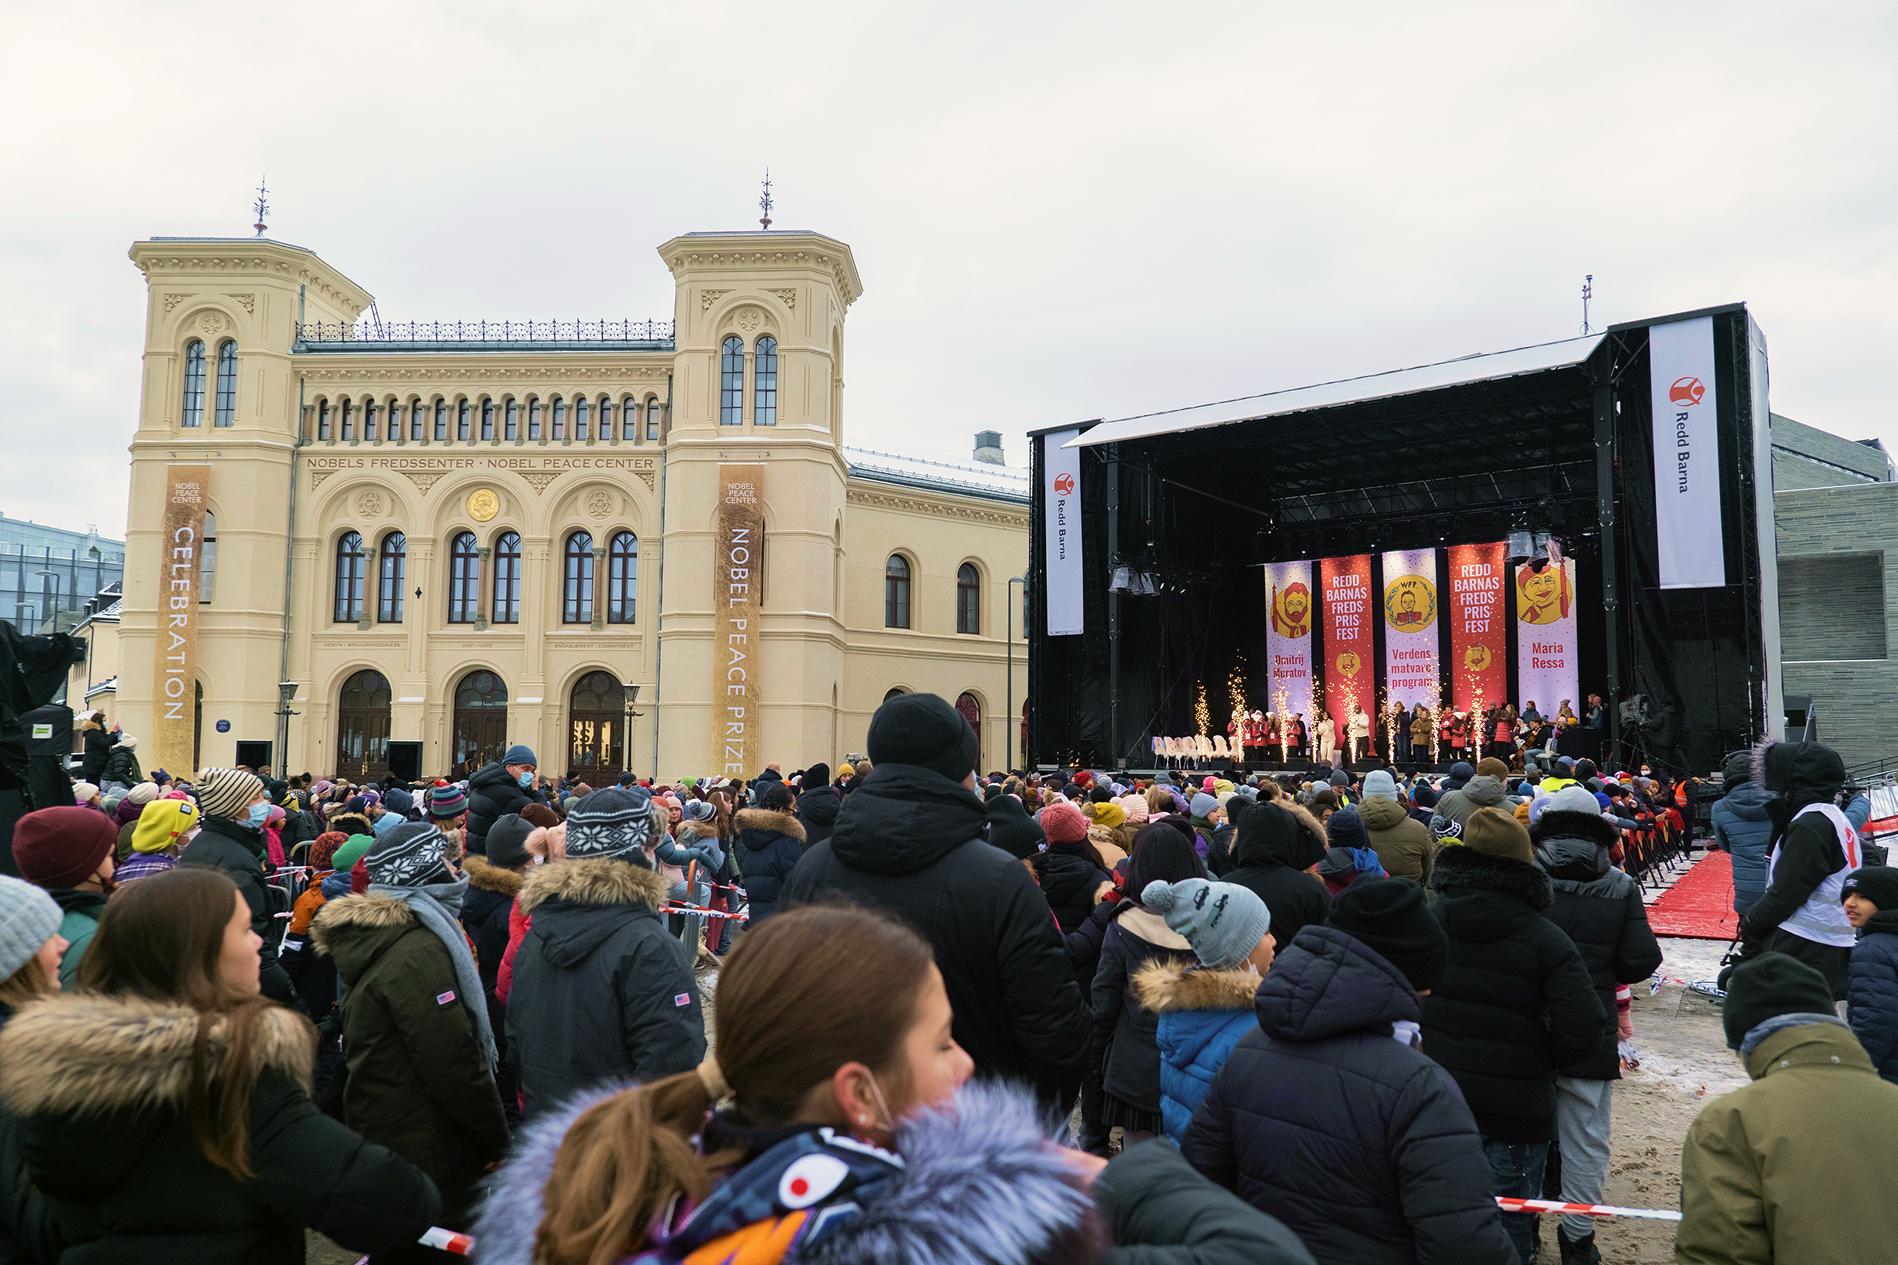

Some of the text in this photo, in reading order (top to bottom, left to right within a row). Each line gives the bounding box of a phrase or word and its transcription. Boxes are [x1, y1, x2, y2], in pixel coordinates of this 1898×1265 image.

[1676, 412, 1690, 494] Redd Barna
[307, 458, 653, 468] NOBELS FREDSSENTER NOBEL PEACE CENTER
[1057, 499, 1067, 560] Redd Barna
[1461, 563, 1491, 578] REDD
[1332, 575, 1360, 588] REDD
[1454, 577, 1499, 592] BARNAS
[1326, 586, 1367, 602] BARNAS
[164, 526, 194, 719] CELEBRATION
[1465, 619, 1490, 633] FEST
[1336, 626, 1359, 640] FEST
[725, 528, 749, 774] NOBEL PEACE PRIZE
[1392, 648, 1431, 660] Verdens
[1532, 642, 1563, 654] Maria
[1275, 654, 1304, 666] Dmitrij
[1532, 657, 1564, 669] Ressa
[1273, 668, 1306, 678] Muratov
[1392, 678, 1432, 690] program
